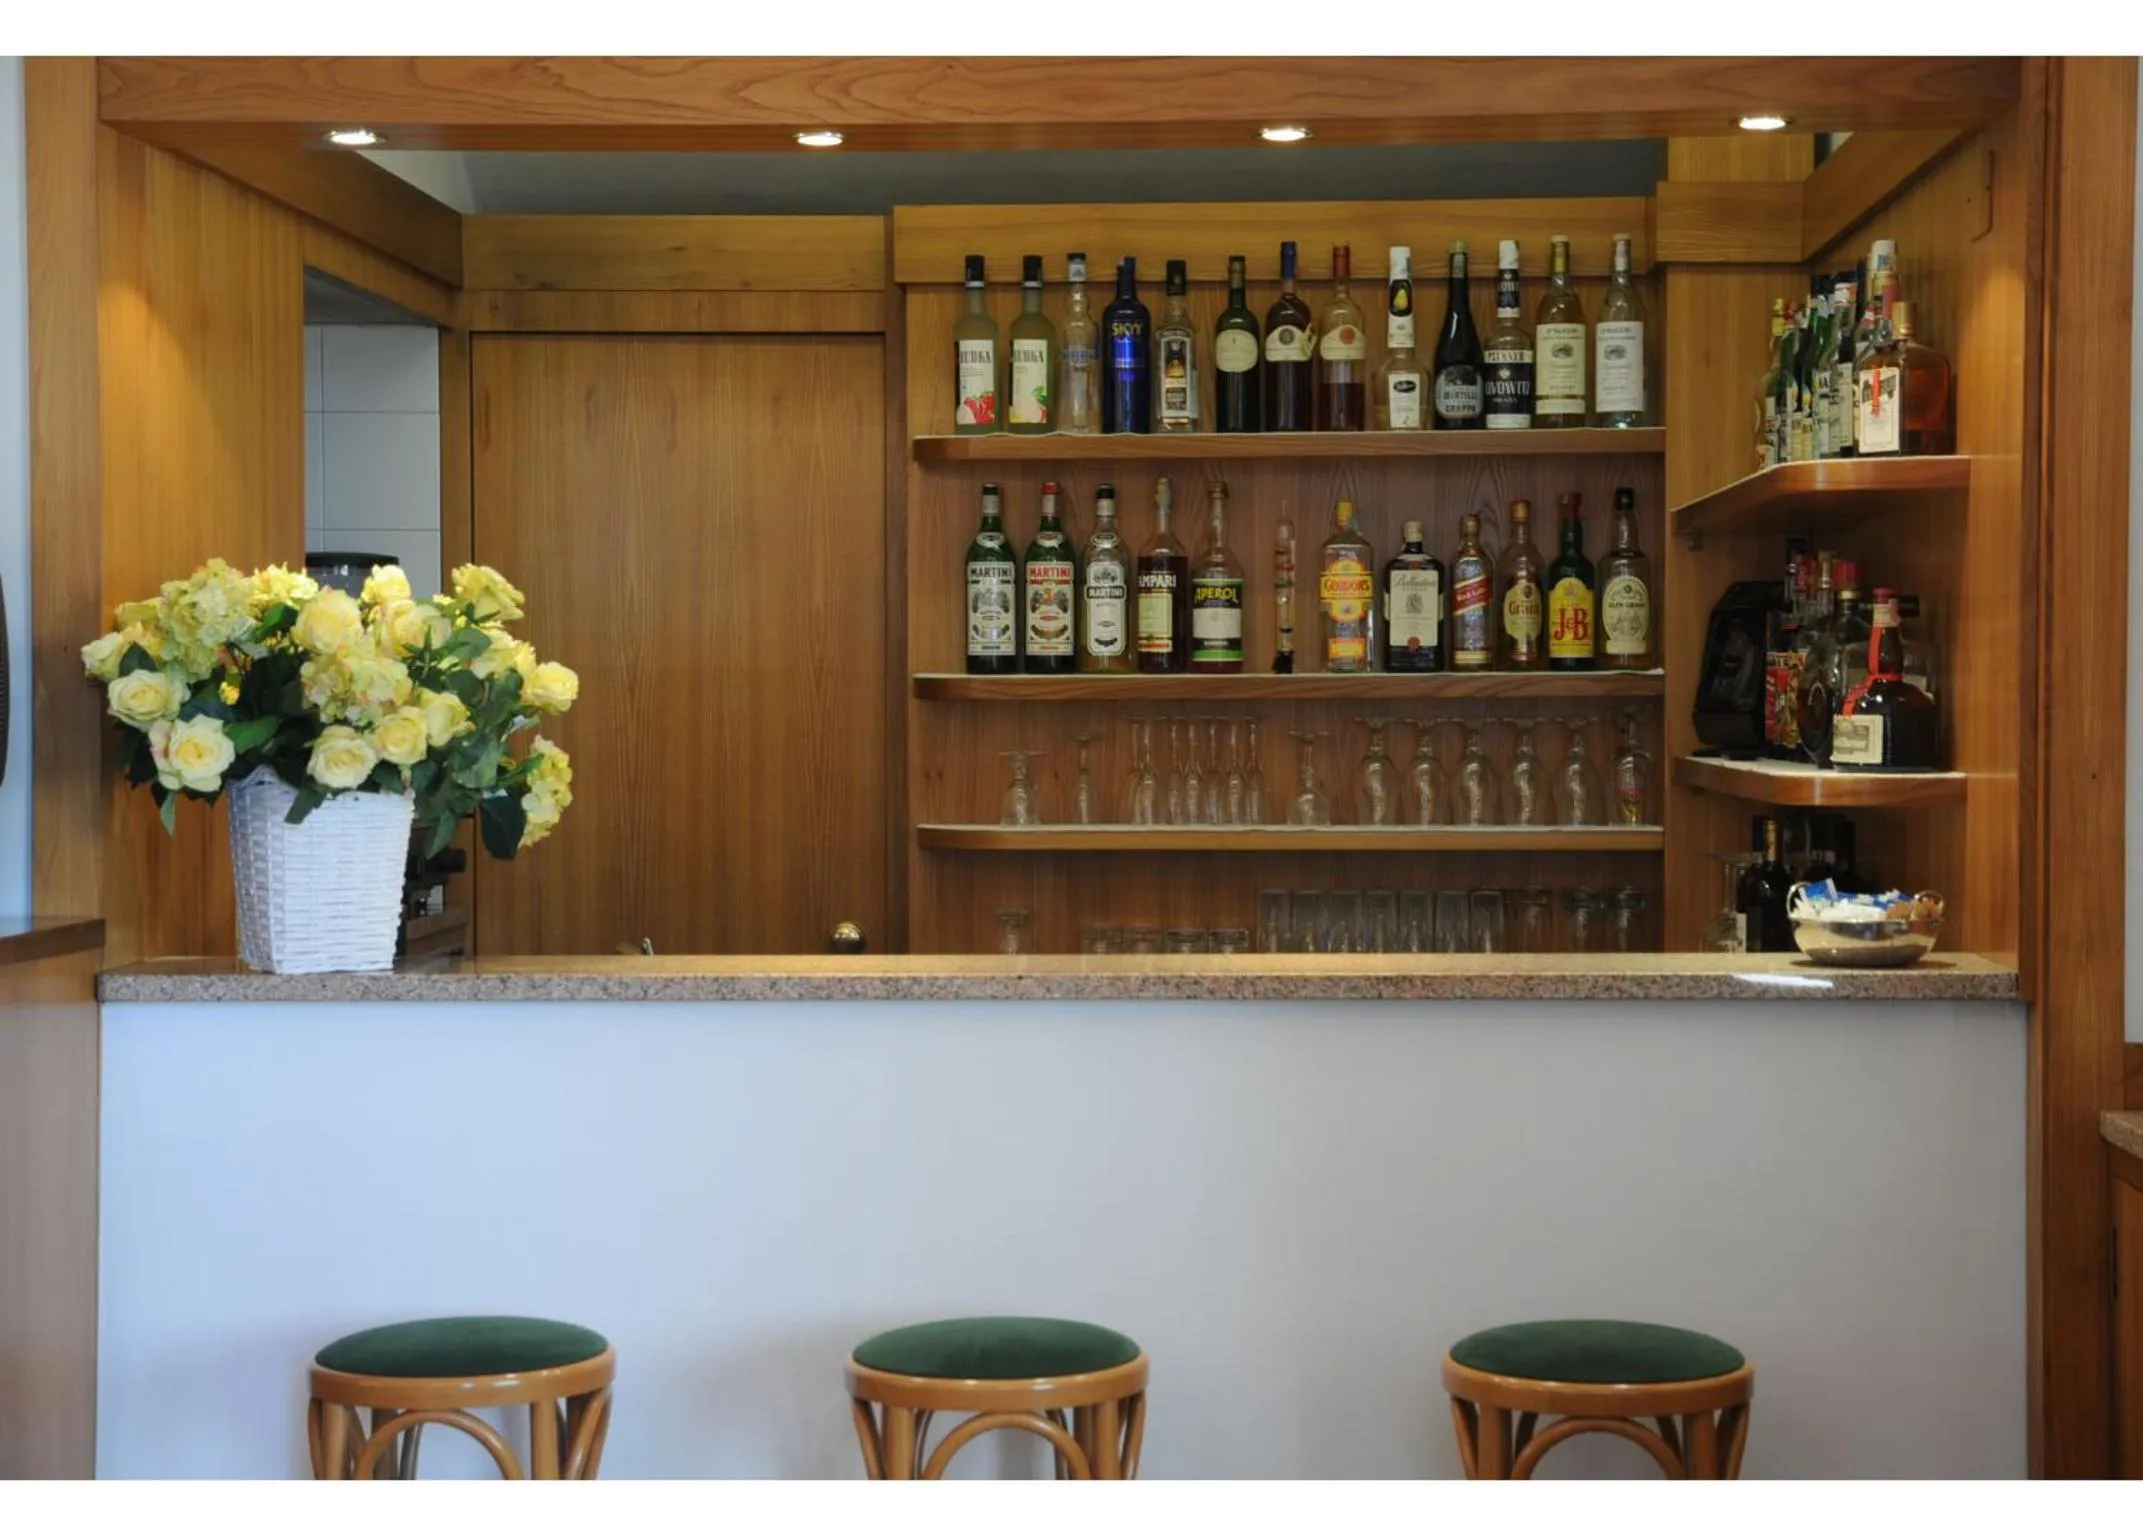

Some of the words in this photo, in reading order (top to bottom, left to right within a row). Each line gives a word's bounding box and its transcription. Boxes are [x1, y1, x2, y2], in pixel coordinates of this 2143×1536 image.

[1111, 322, 1143, 337] SKYY
[970, 567, 1012, 578] MARTINI
[1029, 567, 1071, 578] MARTINI
[1138, 574, 1177, 588] AMPARI
[1088, 588, 1123, 598] MARTINI
[1554, 607, 1589, 641] J&B
